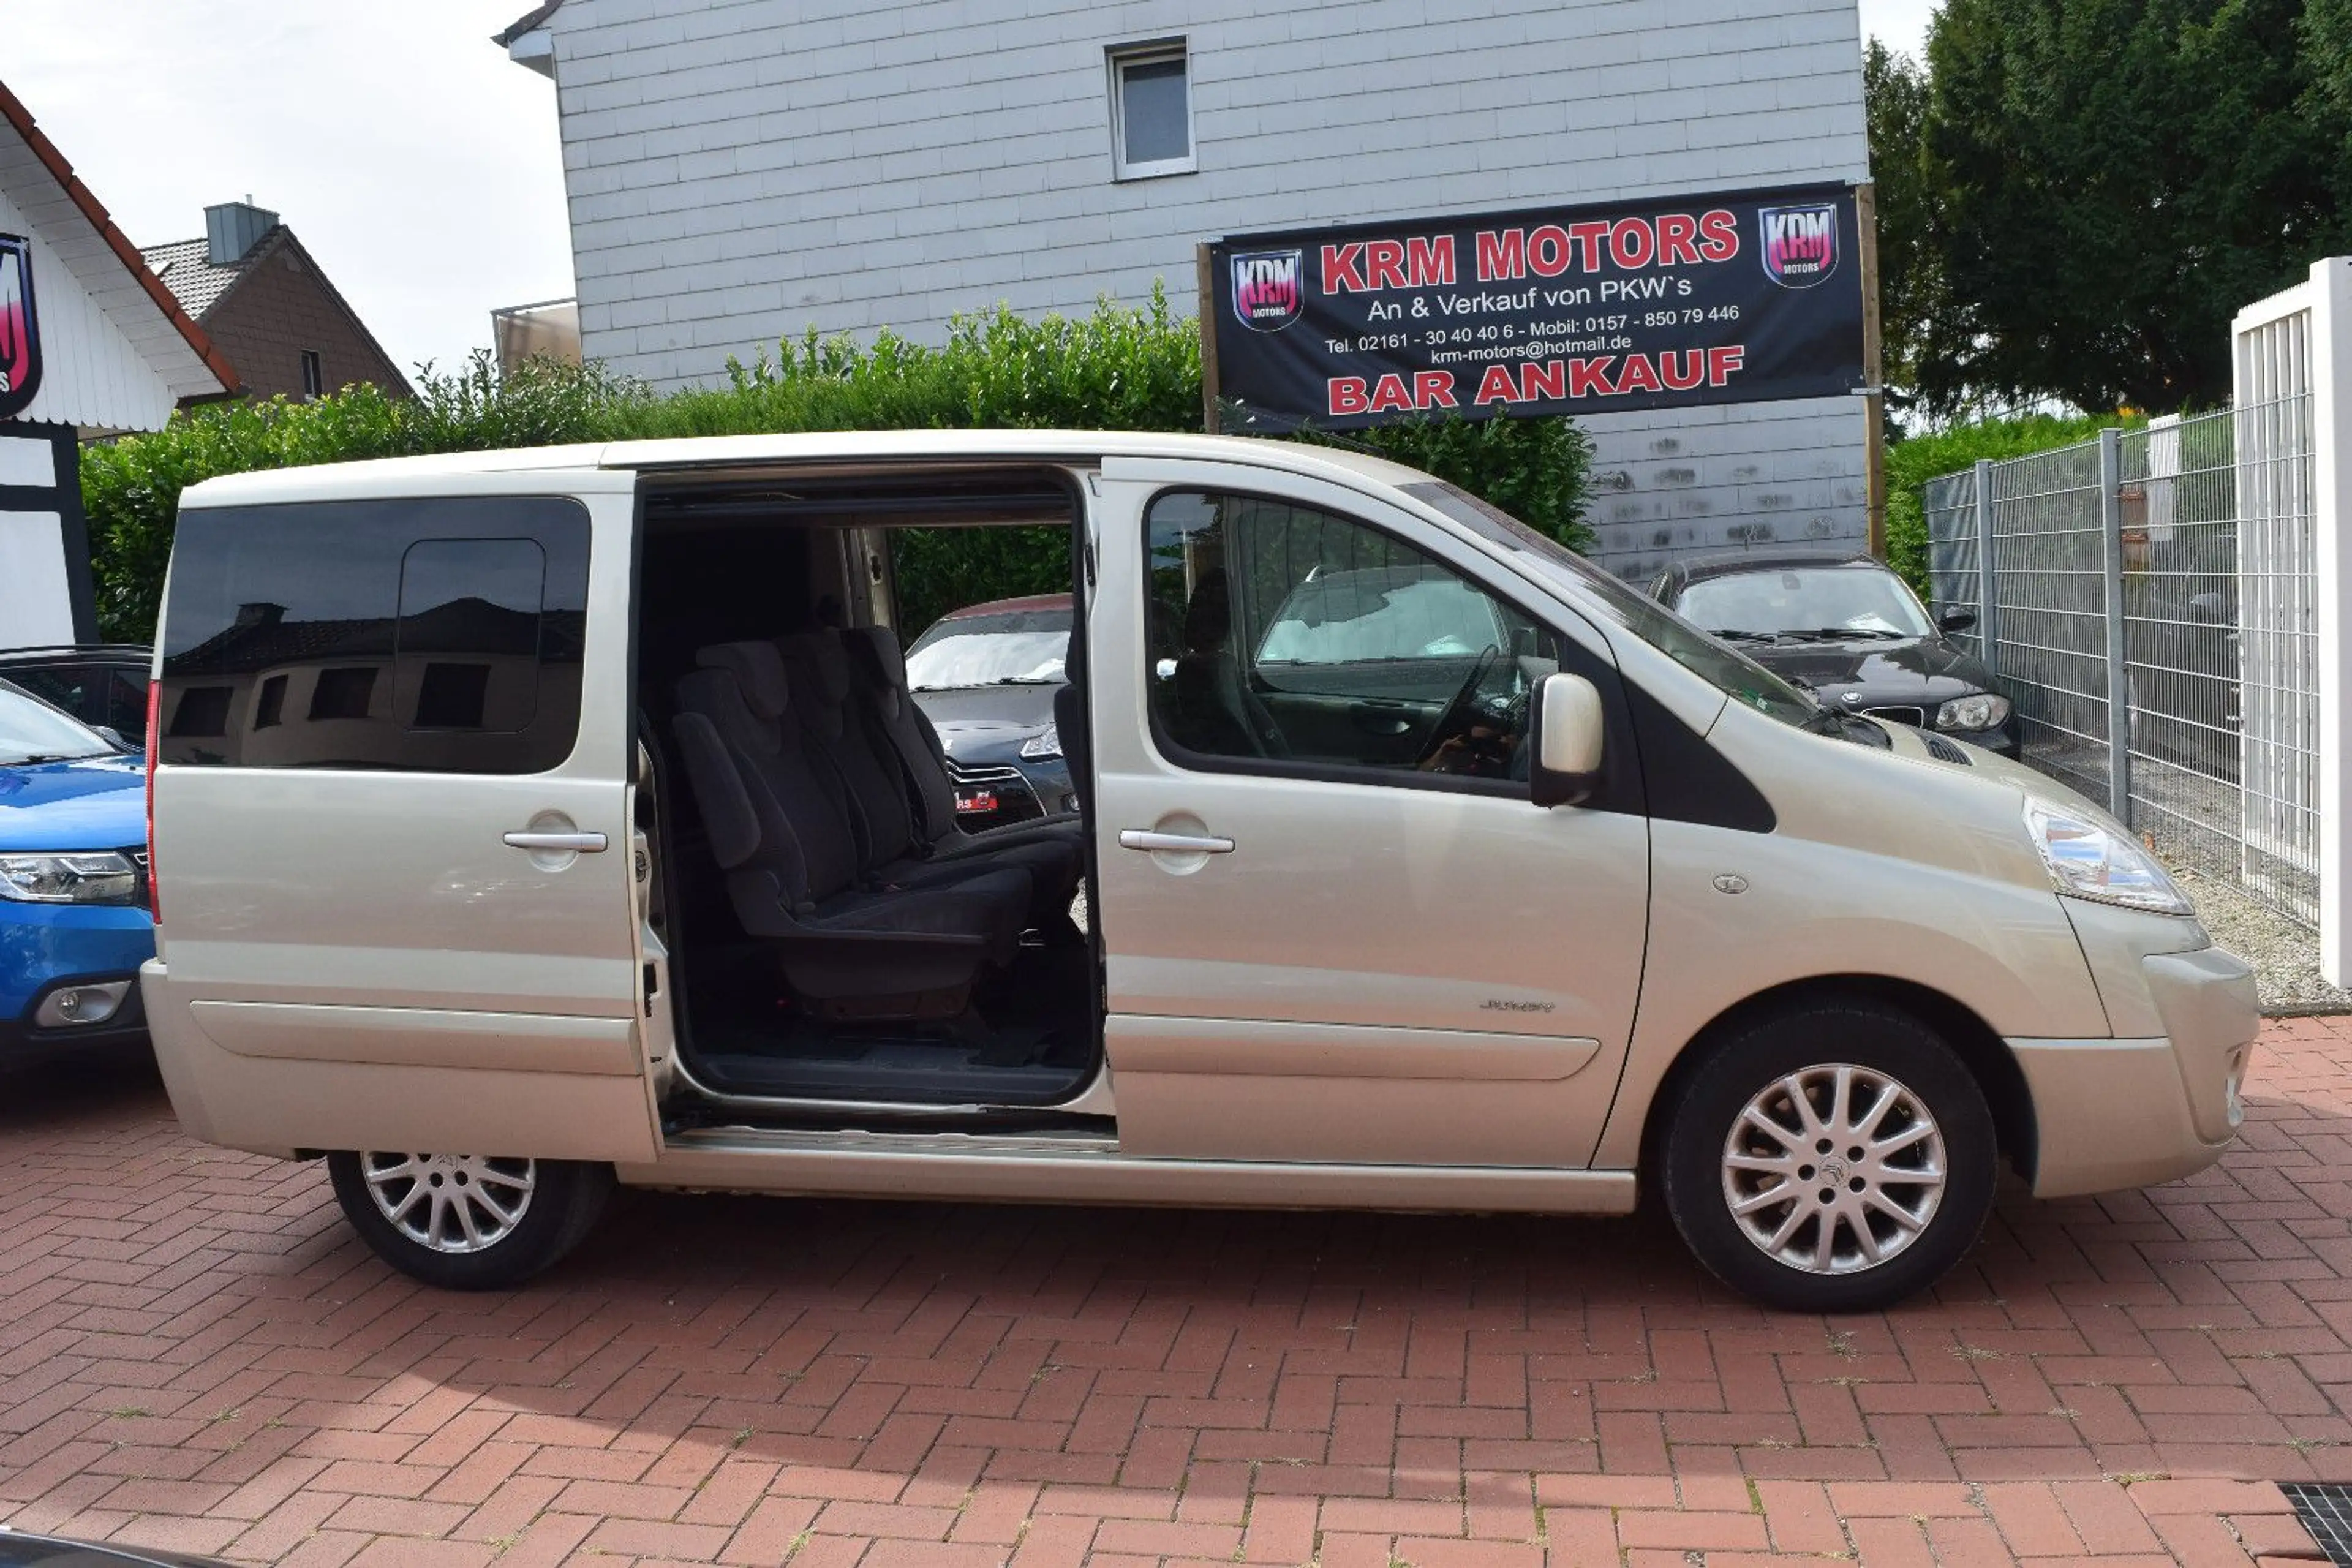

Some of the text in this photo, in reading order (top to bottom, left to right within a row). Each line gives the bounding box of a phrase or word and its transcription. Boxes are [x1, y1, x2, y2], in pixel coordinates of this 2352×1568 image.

[1321, 209, 1740, 295] KRM MOTORS
[1765, 212, 1832, 270] KRM
[1237, 258, 1296, 314] KRM
[1783, 263, 1819, 275] MOTORS
[1253, 307, 1286, 318] MOTORS
[1367, 301, 1402, 321] An
[1411, 297, 1430, 318] &
[1438, 287, 1537, 315] Verkauf
[1544, 287, 1591, 307] von
[1325, 339, 1353, 353] Tel.
[1358, 333, 1408, 351] 02161
[1425, 331, 1446, 345] 30
[1450, 328, 1472, 342] 40
[1477, 326, 1498, 341] 40
[1503, 325, 1514, 337] 6
[1530, 320, 1580, 336] Mobil:
[1585, 315, 1627, 332] 0157
[1645, 311, 1677, 327] 850
[1681, 309, 1703, 323] 79
[1708, 306, 1740, 321] 446
[1431, 335, 1632, 364] krm-motors@hotmail.de
[1327, 345, 1744, 415] BAR ANKAUF
